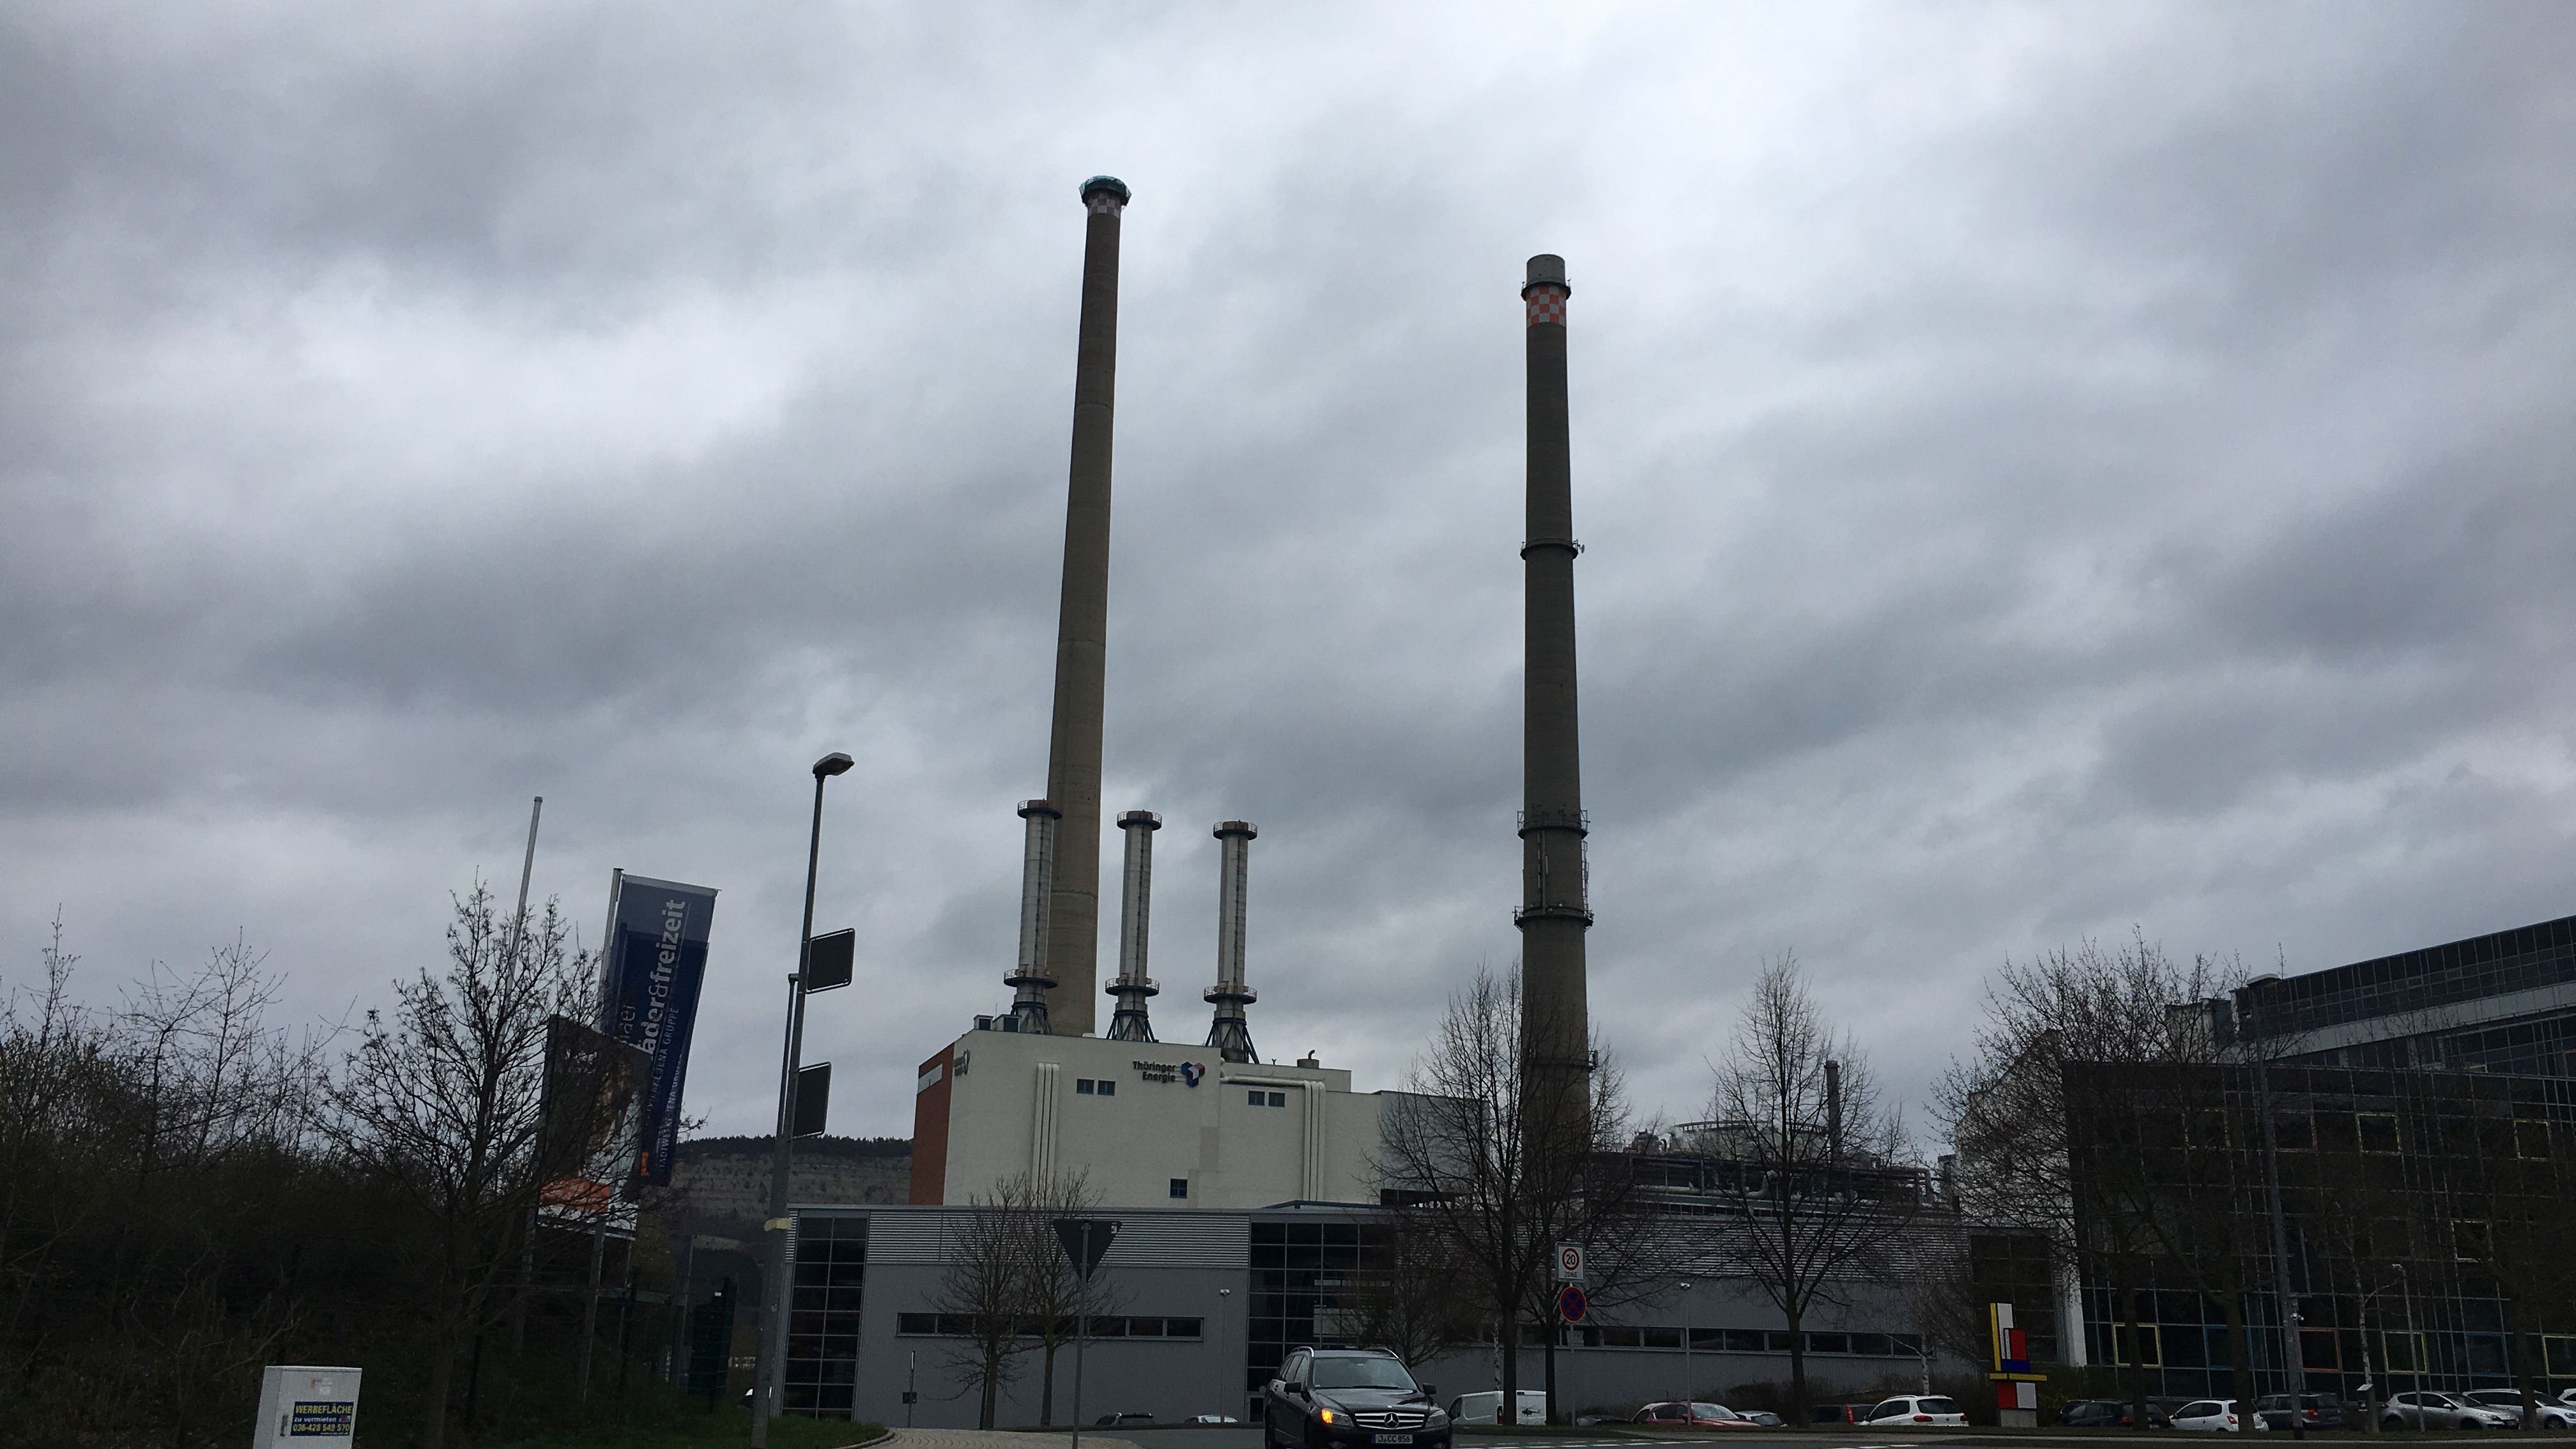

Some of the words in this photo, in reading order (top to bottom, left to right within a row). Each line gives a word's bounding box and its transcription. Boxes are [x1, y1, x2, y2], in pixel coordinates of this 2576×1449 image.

[663, 1008, 679, 1045] GRUPPE
[1132, 1061, 1176, 1073] Thüringer
[1142, 1071, 1176, 1084] Energie
[1565, 1254, 1576, 1265] 20
[295, 1403, 353, 1414] WERBEFLÄCHE
[337, 1423, 350, 1432] 570
